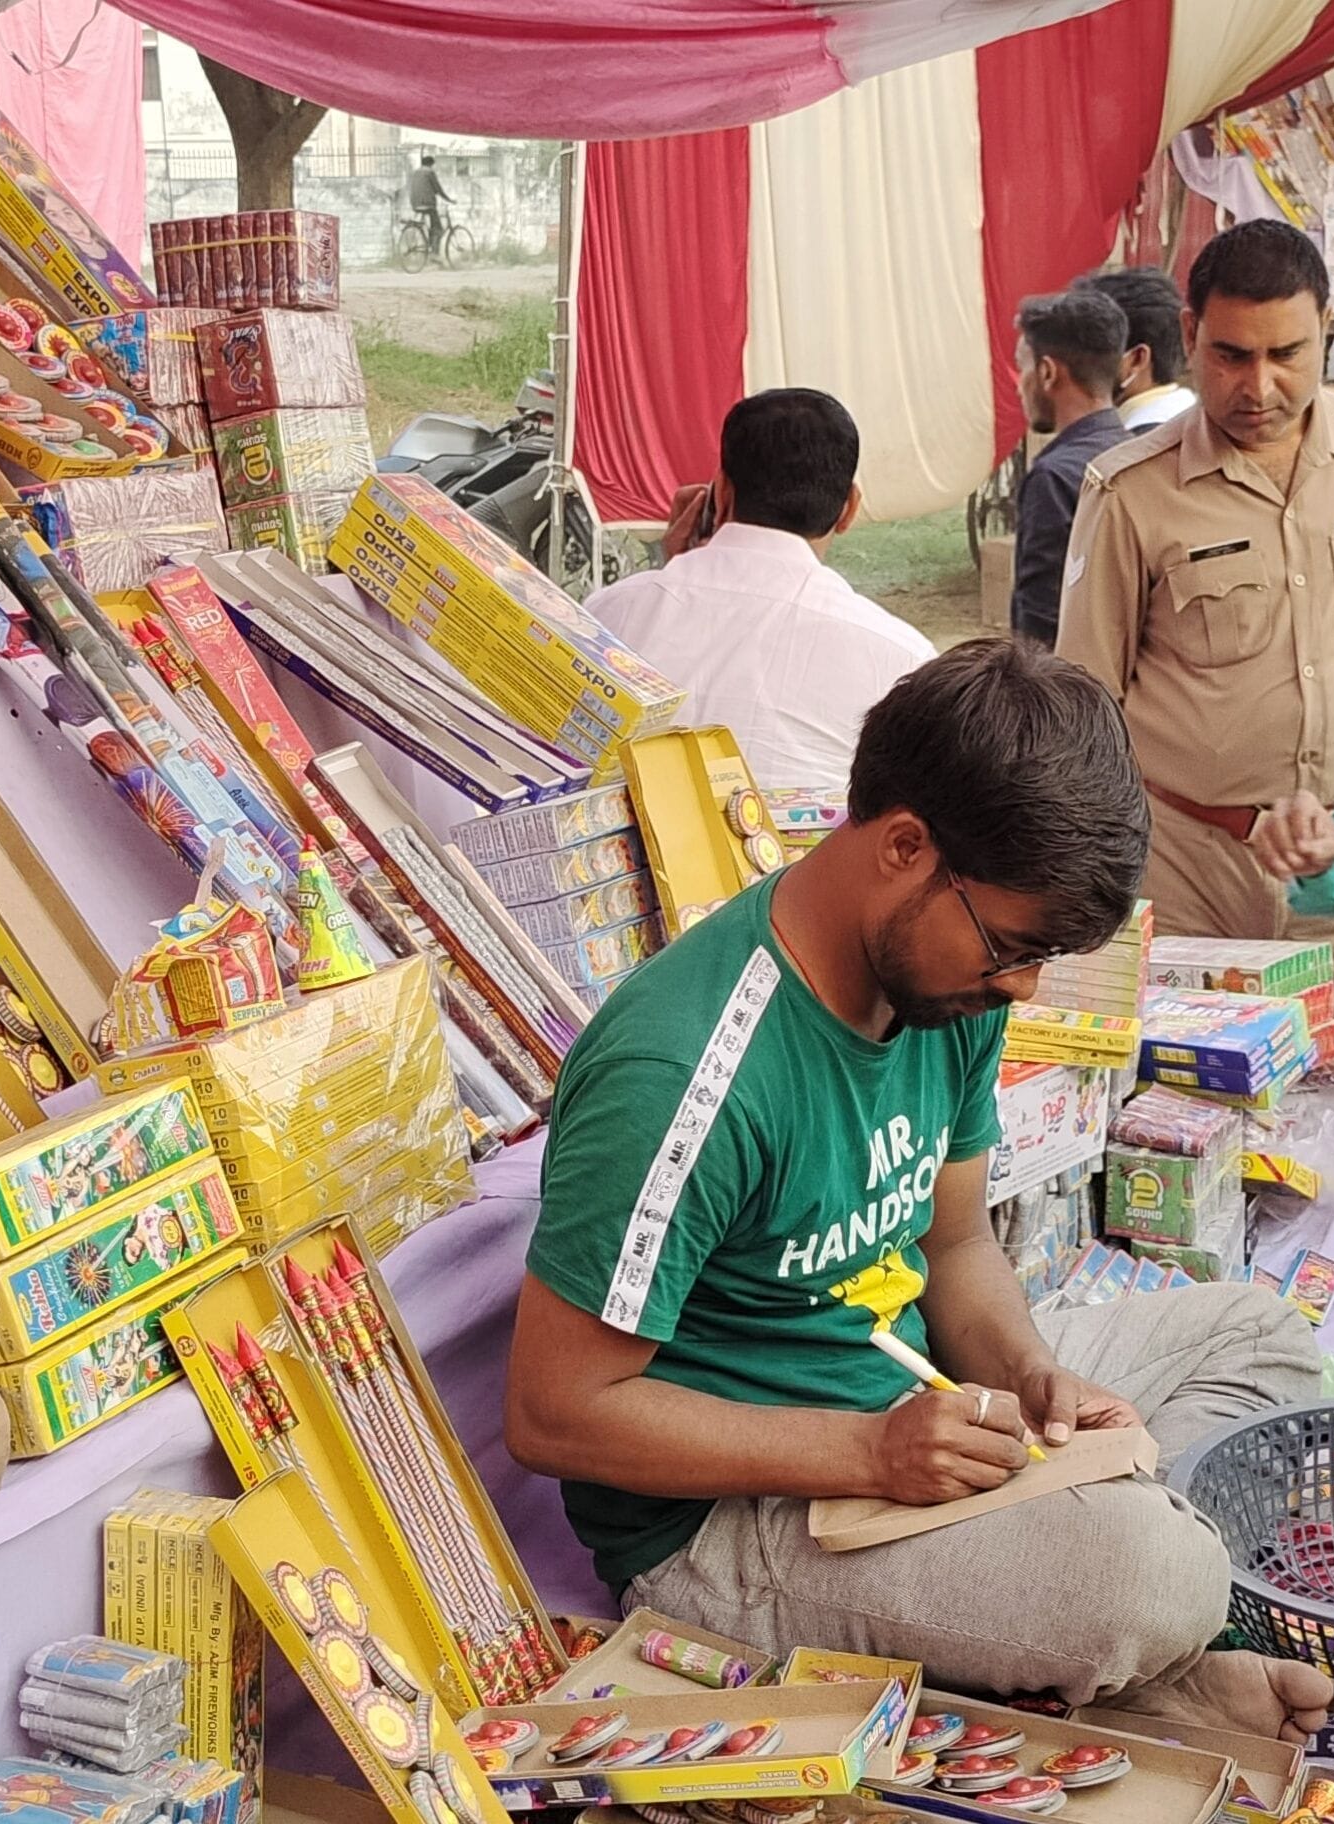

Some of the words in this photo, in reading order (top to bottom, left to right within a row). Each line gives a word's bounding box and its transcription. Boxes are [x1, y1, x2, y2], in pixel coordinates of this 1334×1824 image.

[74, 269, 110, 315] EXPO
[374, 513, 417, 552] EXPO
[363, 529, 407, 571] EXPO
[355, 546, 399, 587] EXPO
[348, 564, 391, 603] EXPO
[184, 607, 223, 632] RED
[570, 657, 617, 699] EXPO
[464, 781, 495, 806] CAUTION
[325, 910, 351, 932] GRE
[231, 1007, 266, 1023] SERPENT
[1155, 999, 1244, 1019] SUPER
[1011, 1024, 1049, 1038] FACTORY
[1068, 1032, 1101, 1045] (INDIA)
[132, 1061, 165, 1082] Chakkar
[185, 1055, 202, 1068] 10
[515, 1053, 552, 1090] SIVAKASI
[196, 1081, 213, 1095] 10
[210, 1107, 227, 1120] 10
[212, 1136, 229, 1149] 10
[866, 1114, 925, 1190] MR.
[222, 1162, 238, 1175] 10
[232, 1188, 249, 1201] 10
[1128, 1175, 1160, 1209] 2
[246, 1214, 264, 1227] 10
[1124, 1206, 1164, 1222] SOUND
[29, 1269, 57, 1333] Rekha
[167, 1538, 177, 1570] NCLE
[194, 1541, 204, 1575] NCLE
[136, 1573, 147, 1613] (INDIA)
[211, 1600, 222, 1626] Mfg.
[135, 1615, 146, 1640] U.P.
[208, 1627, 220, 1645] By
[209, 1651, 220, 1681] AZIM.
[207, 1684, 219, 1750] FIREWORKS
